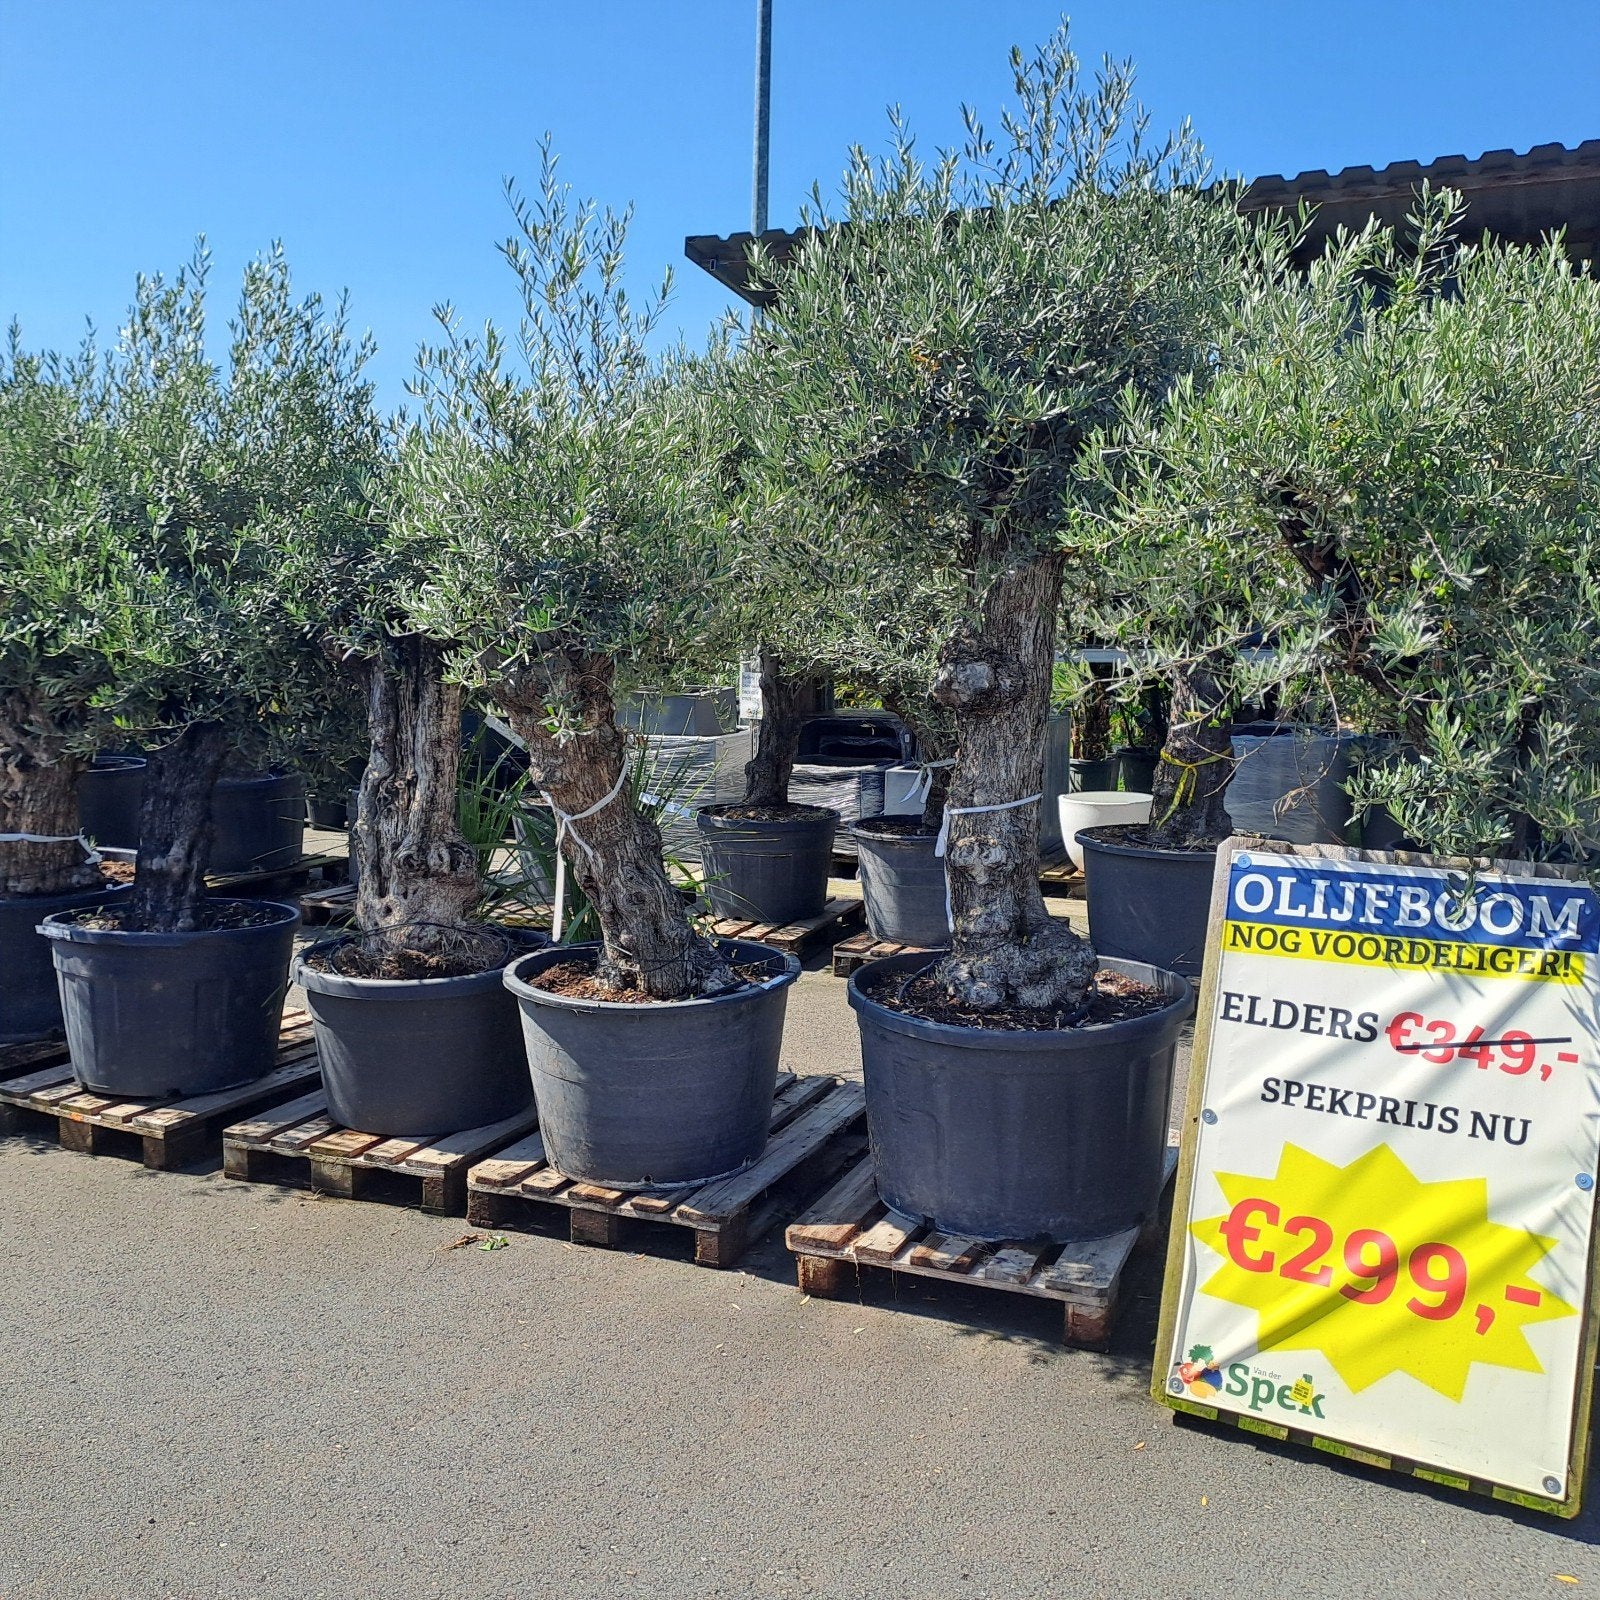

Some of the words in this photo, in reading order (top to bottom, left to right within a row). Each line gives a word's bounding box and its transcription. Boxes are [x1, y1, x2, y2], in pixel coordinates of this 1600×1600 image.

[1234, 873, 1585, 940] OLIJFBOOM
[1229, 924, 1302, 953] NOG
[1309, 932, 1573, 978] VOORDELIGER!
[1219, 991, 1379, 1042] ELDERS
[1384, 1011, 1579, 1082] €349,-
[1260, 1077, 1460, 1134] SPEKPRIJS
[1468, 1111, 1533, 1146] NU
[1219, 1198, 1541, 1336] €299,-
[1253, 1366, 1268, 1376] Van
[1268, 1370, 1282, 1380] der
